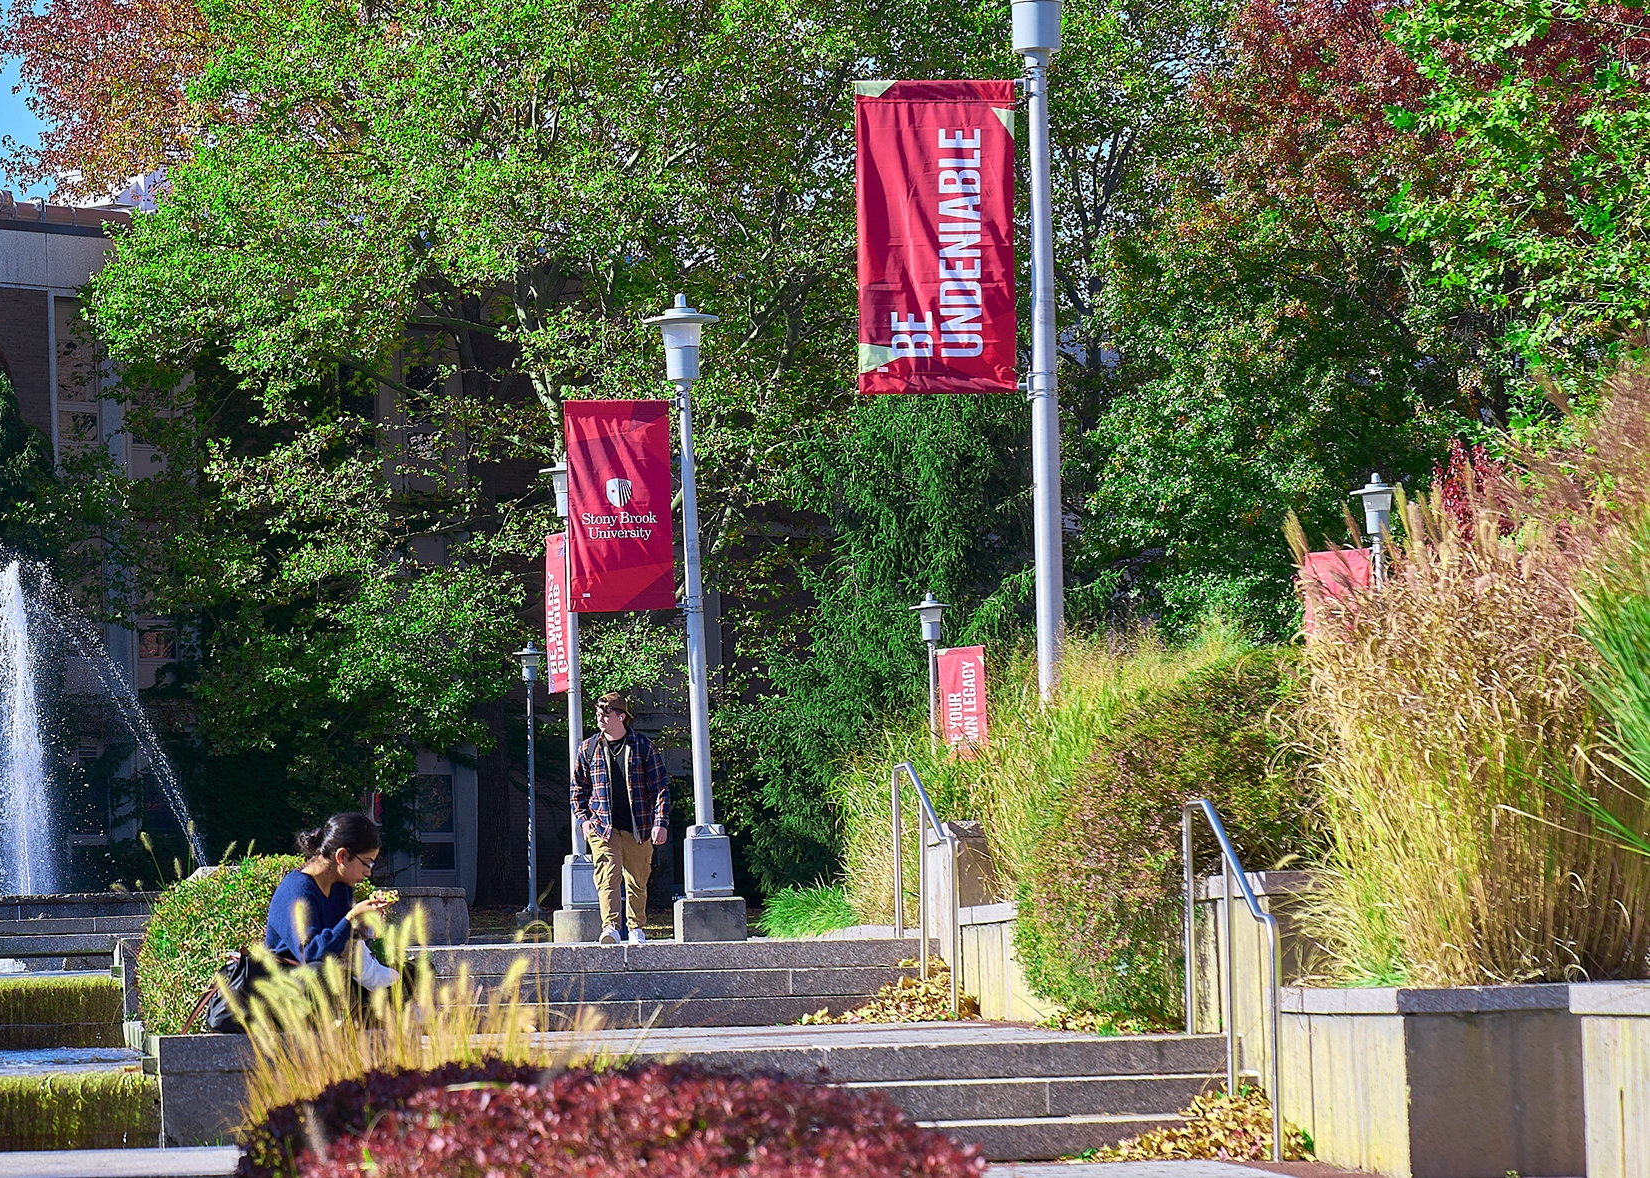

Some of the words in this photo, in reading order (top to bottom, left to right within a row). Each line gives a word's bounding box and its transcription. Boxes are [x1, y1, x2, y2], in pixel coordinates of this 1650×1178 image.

[938, 128, 983, 358] UNDENIABLE
[890, 311, 934, 358] BE
[581, 512, 618, 526] Stony
[619, 511, 658, 524] Brook
[587, 526, 652, 540] University
[553, 583, 569, 674] CURIOUS
[549, 649, 558, 674] BE
[961, 660, 976, 712] LEGACY
[948, 691, 962, 730] YOUR
